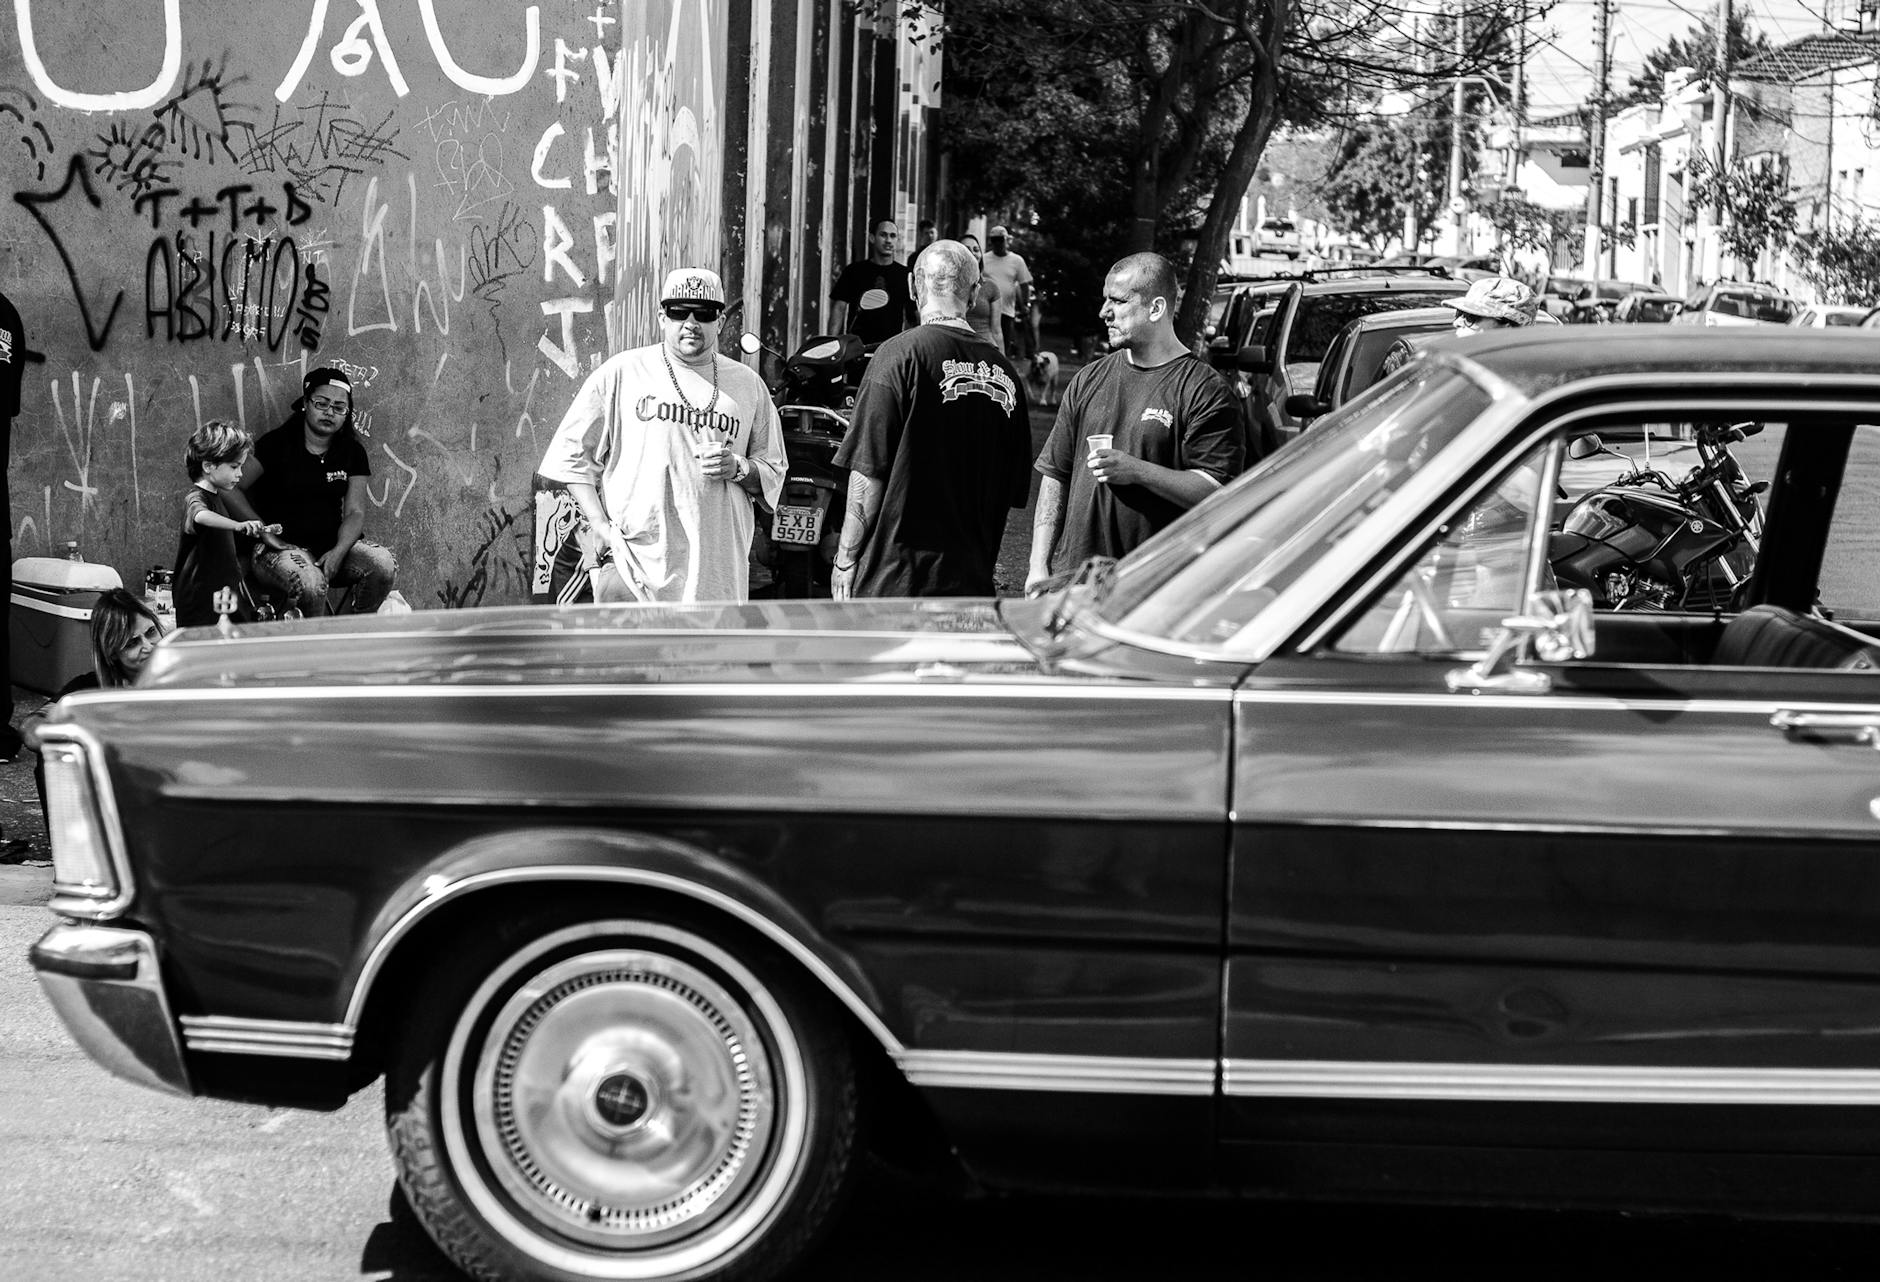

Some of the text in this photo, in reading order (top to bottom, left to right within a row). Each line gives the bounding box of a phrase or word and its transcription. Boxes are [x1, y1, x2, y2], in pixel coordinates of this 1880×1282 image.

[636, 395, 740, 439] Compton
[790, 476, 814, 484] HONDA
[779, 514, 816, 529] EXB
[777, 527, 816, 542] 9578
